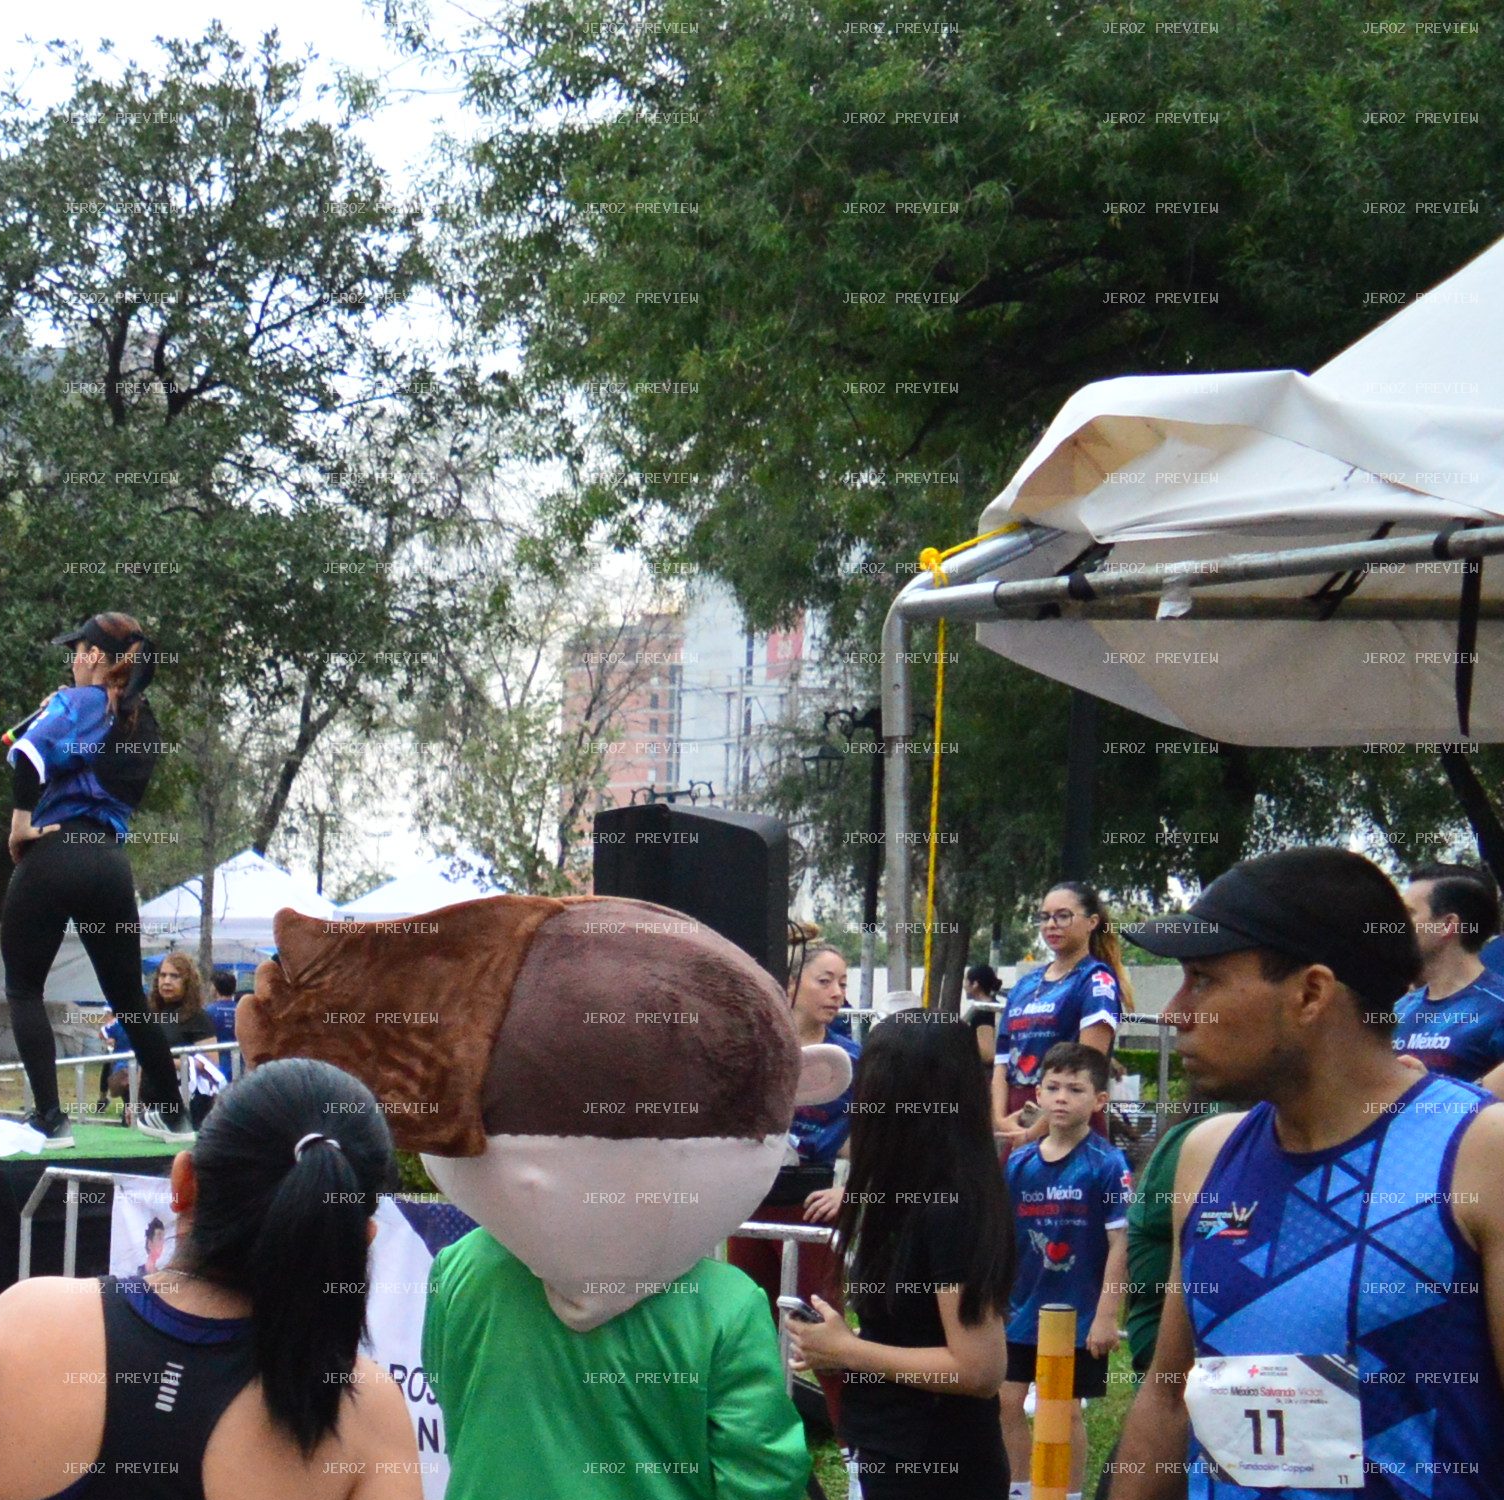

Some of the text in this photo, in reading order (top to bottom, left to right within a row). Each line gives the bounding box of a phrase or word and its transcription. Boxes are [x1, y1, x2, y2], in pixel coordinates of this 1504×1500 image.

[1407, 1032, 1451, 1050] México
[1021, 1186, 1082, 1202] Todo México
[1230, 1386, 1259, 1397] México
[1260, 1386, 1297, 1398] Salvando
[1244, 1409, 1285, 1456] 11
[1338, 1474, 1349, 1485] 11
